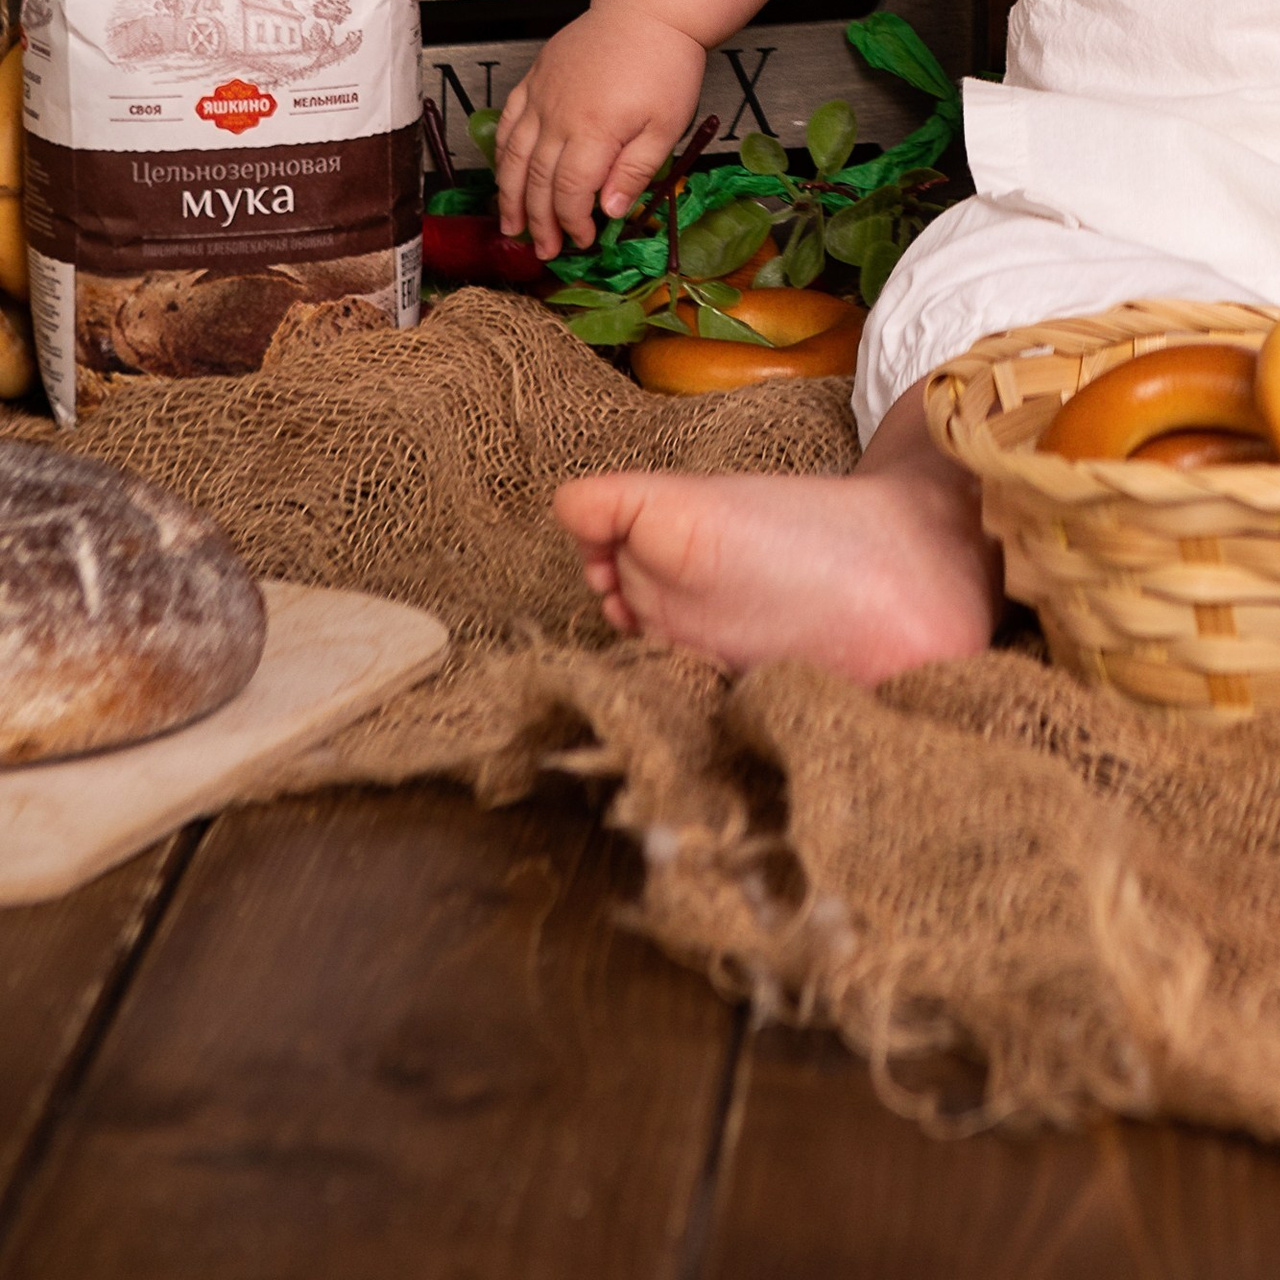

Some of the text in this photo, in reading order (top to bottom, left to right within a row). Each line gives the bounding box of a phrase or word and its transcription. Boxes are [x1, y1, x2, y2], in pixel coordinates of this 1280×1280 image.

[129, 92, 360, 116] СВОЯ ЯШКИНО МЕЛЬНИЦА
[131, 155, 342, 187] Цельнозерновая
[182, 184, 295, 228] мука
